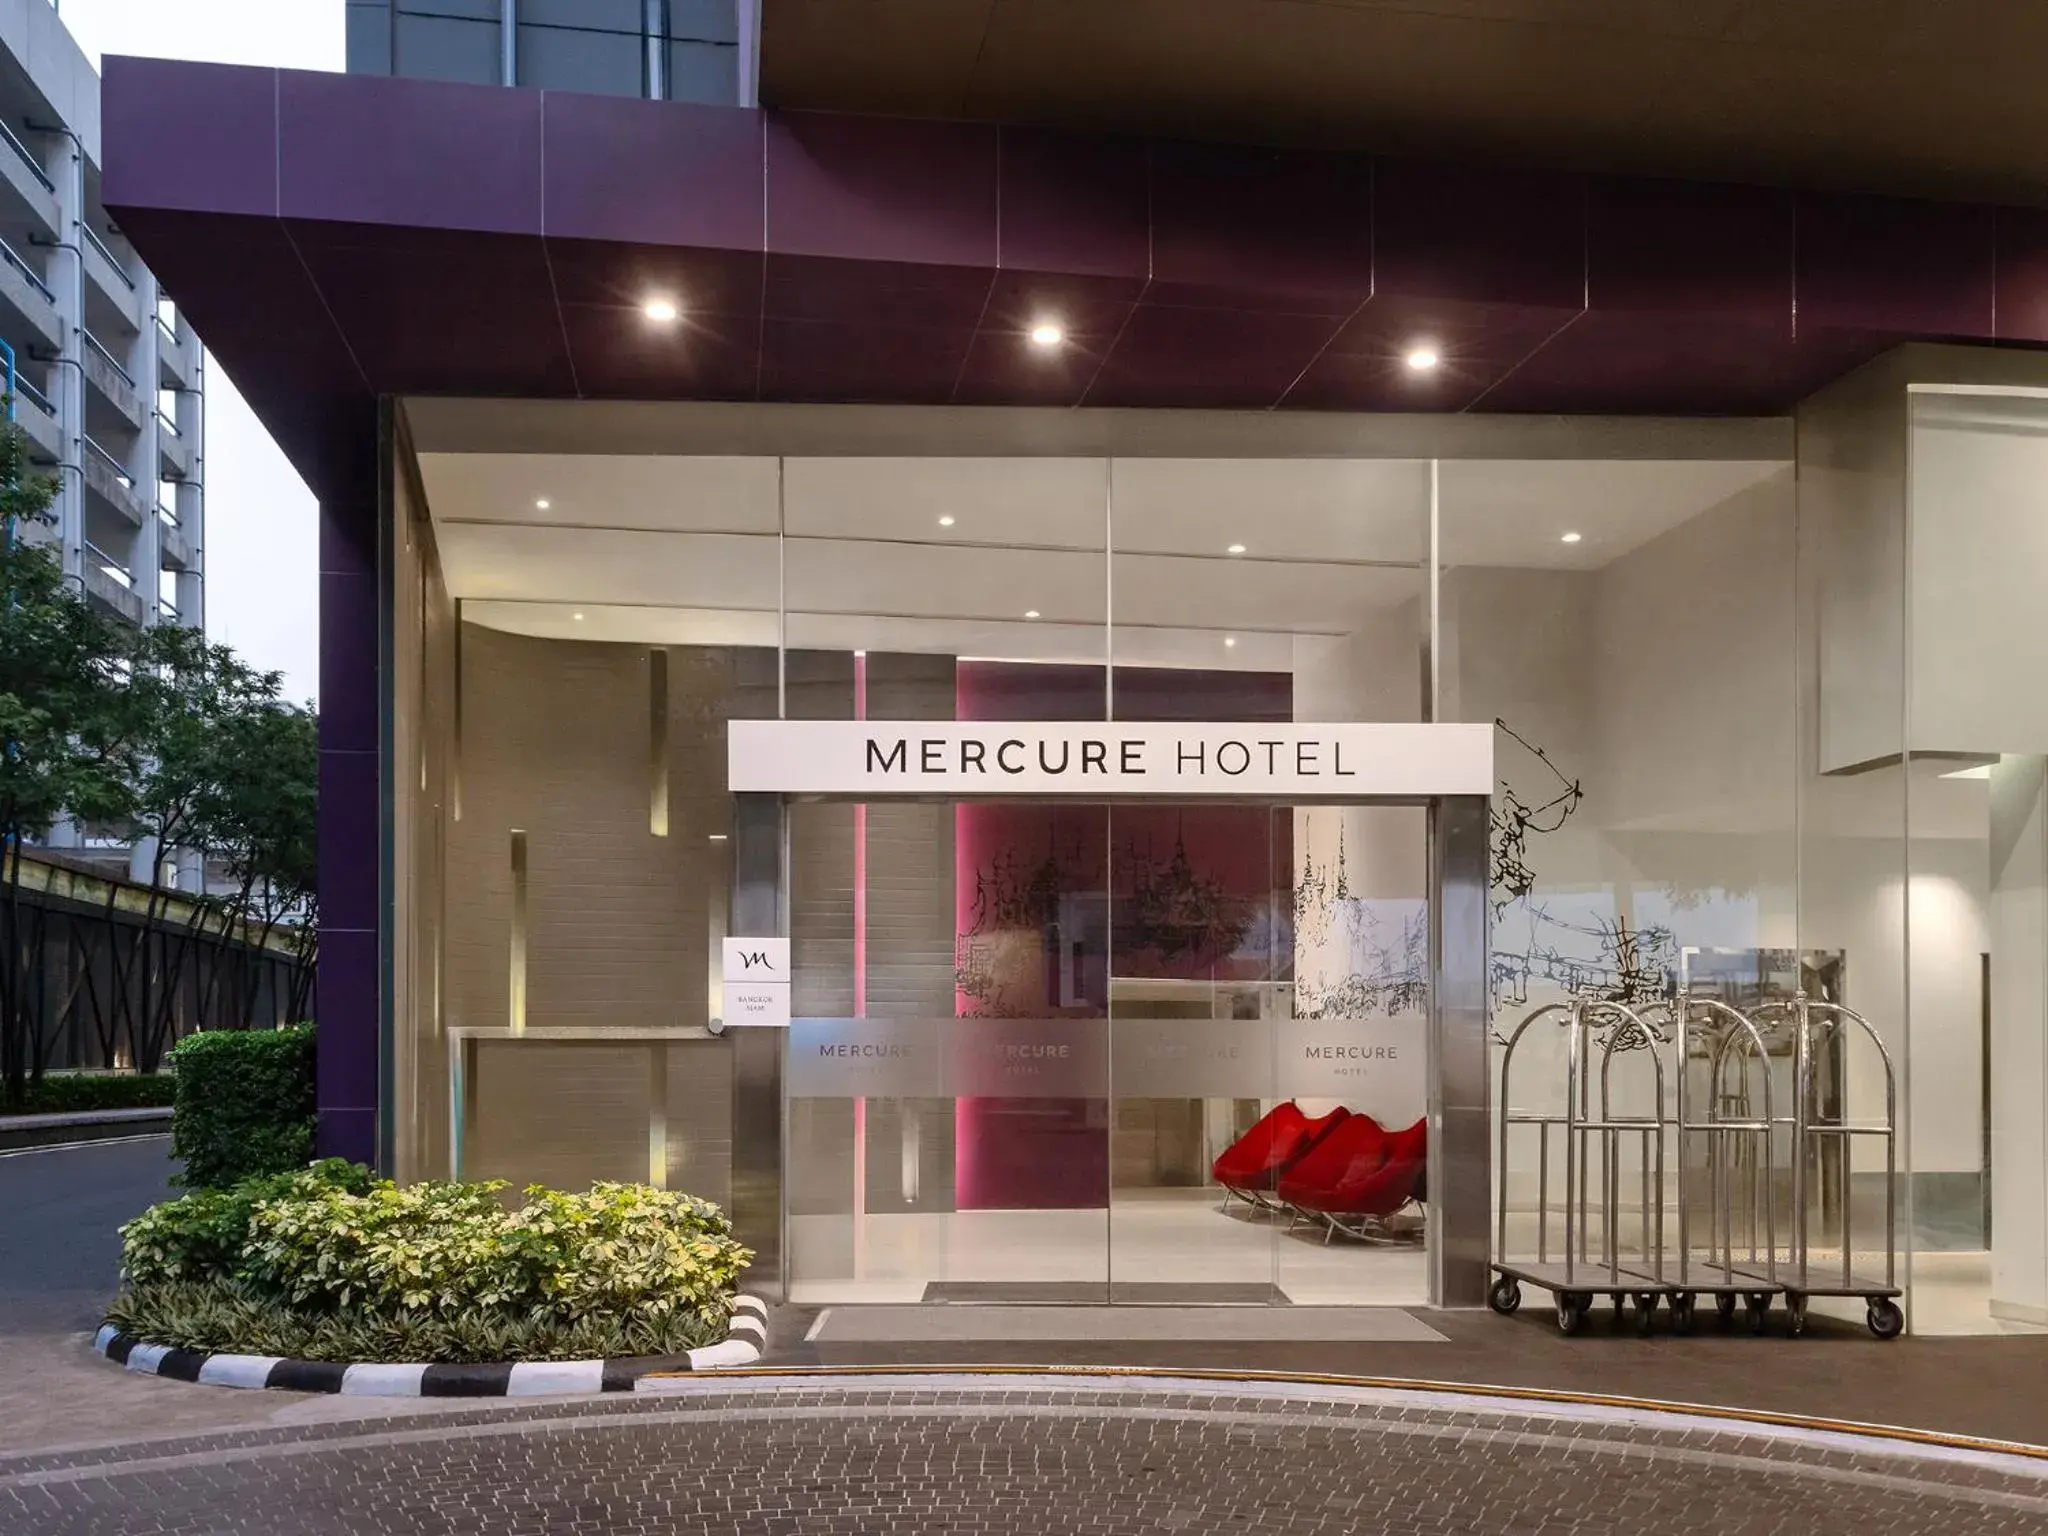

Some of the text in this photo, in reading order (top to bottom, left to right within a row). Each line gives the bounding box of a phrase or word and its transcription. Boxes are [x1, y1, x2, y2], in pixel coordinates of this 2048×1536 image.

[866, 739, 1356, 775] MERCURE HOTEL
[819, 1044, 913, 1057] MERCURE
[1305, 1046, 1398, 1059] MERCURE
[1333, 1067, 1367, 1076] HOTEL
